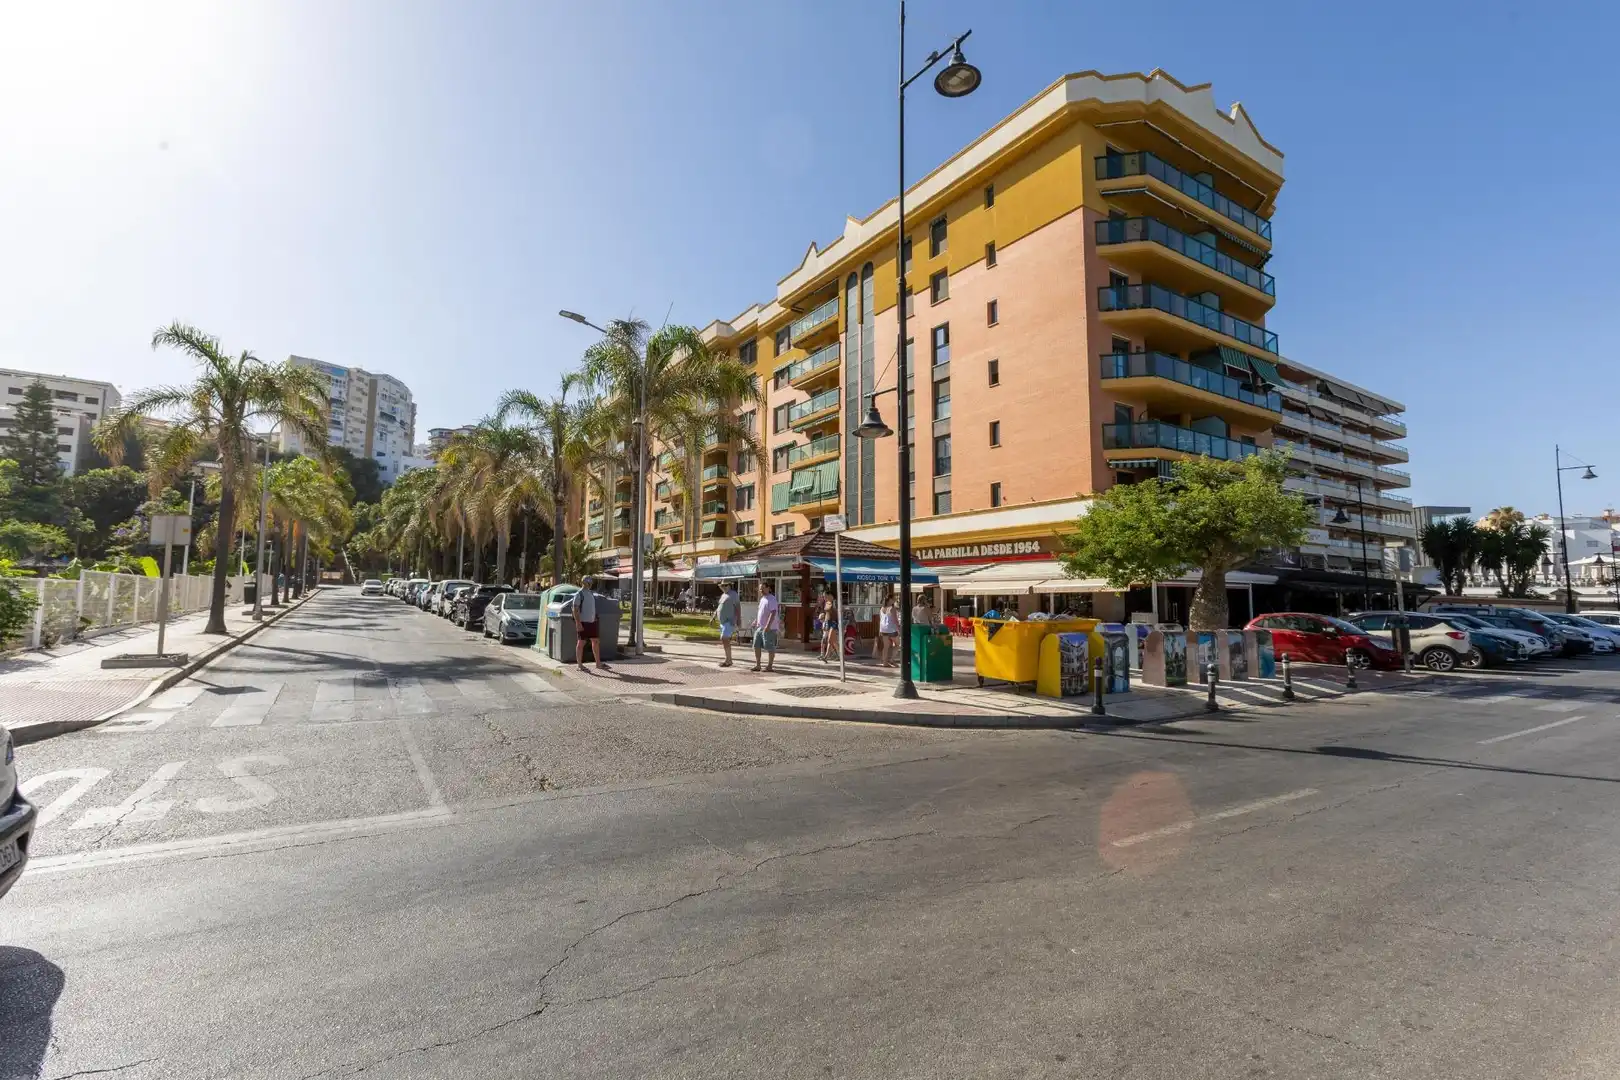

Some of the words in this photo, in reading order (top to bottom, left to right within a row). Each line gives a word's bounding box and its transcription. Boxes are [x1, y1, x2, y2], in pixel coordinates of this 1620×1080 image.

[922, 549, 934, 559] LA
[934, 545, 980, 559] PARRILLA
[981, 543, 1013, 556] DESDE
[1013, 540, 1040, 554] 1954
